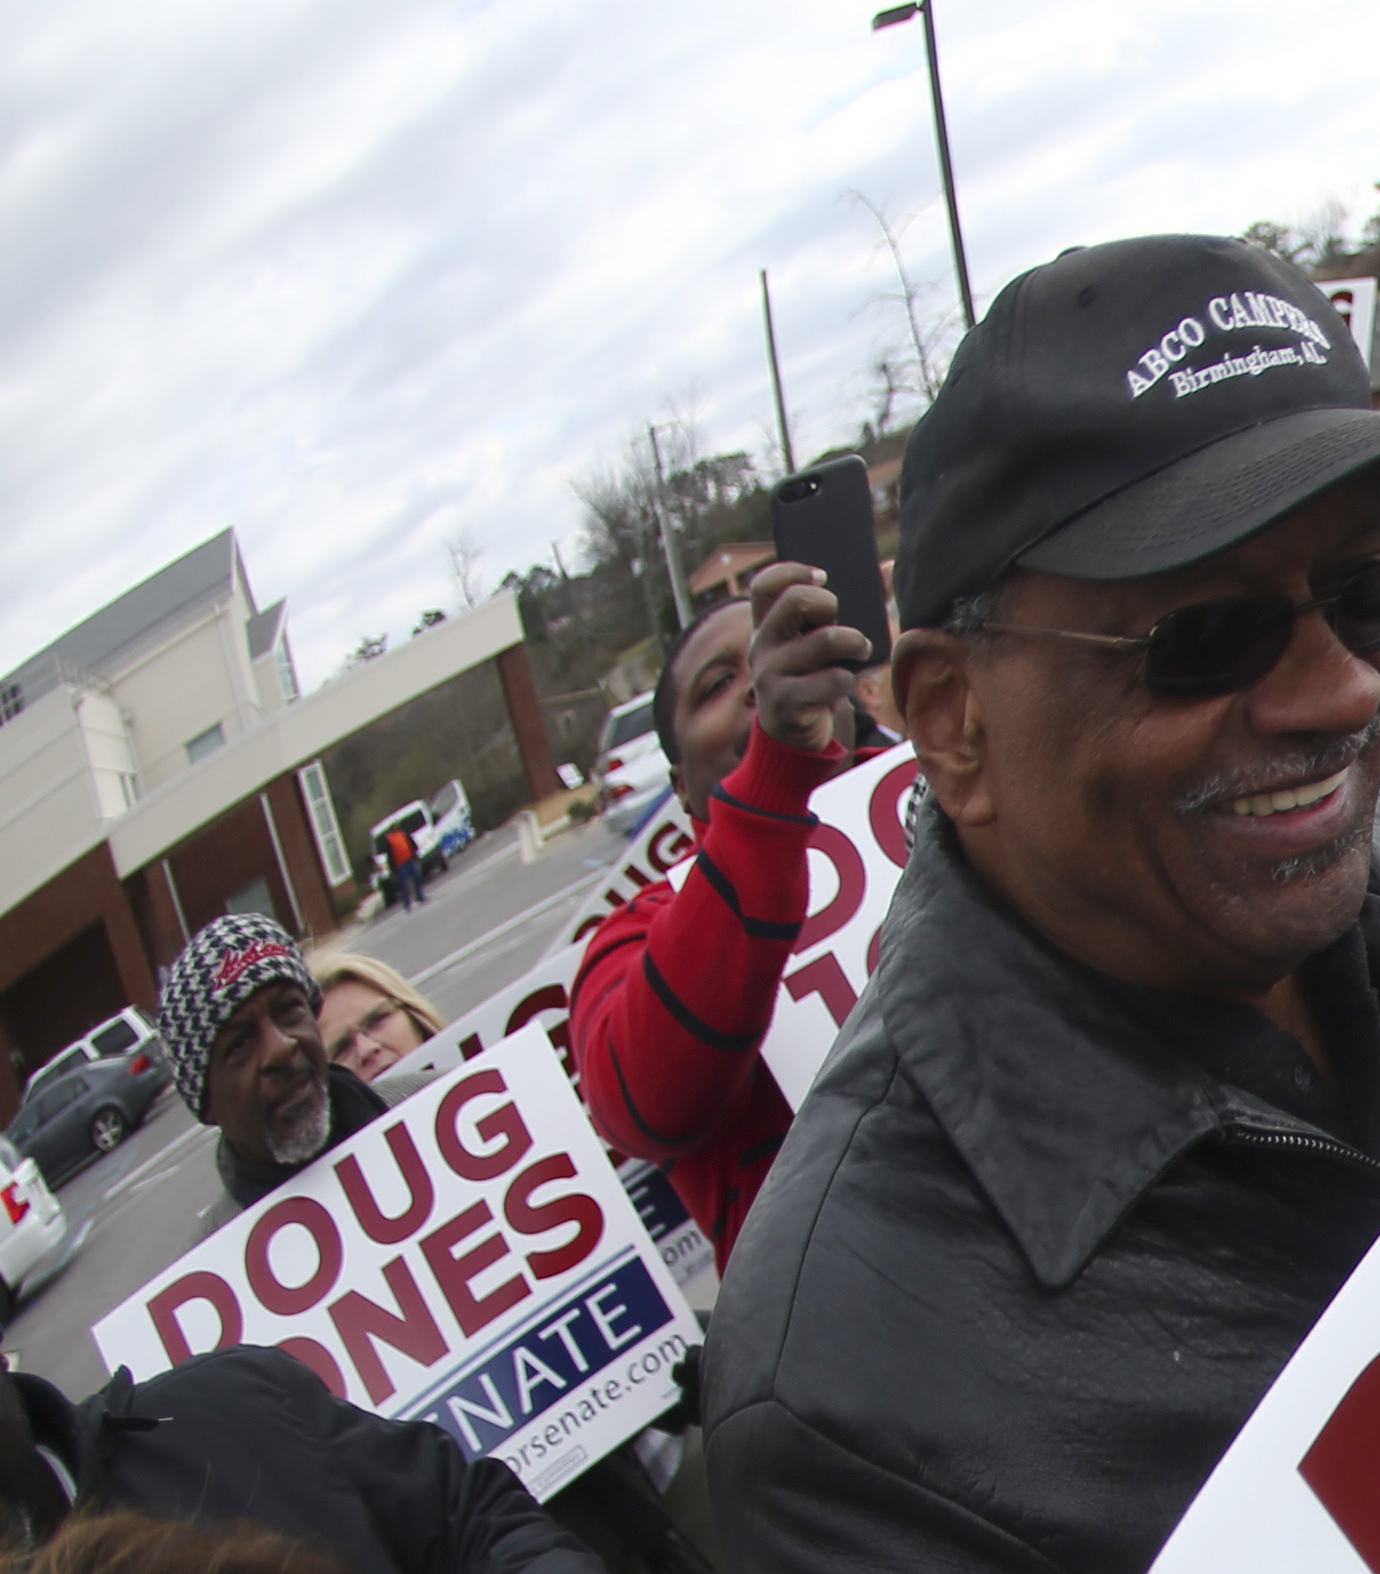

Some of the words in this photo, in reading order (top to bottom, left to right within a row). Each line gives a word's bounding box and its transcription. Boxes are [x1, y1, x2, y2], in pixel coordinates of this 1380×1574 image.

[1126, 317, 1205, 399] ABCO
[1167, 345, 1304, 398] Birmingham,
[1301, 341, 1329, 365] AL
[146, 1069, 534, 1368] DOUG
